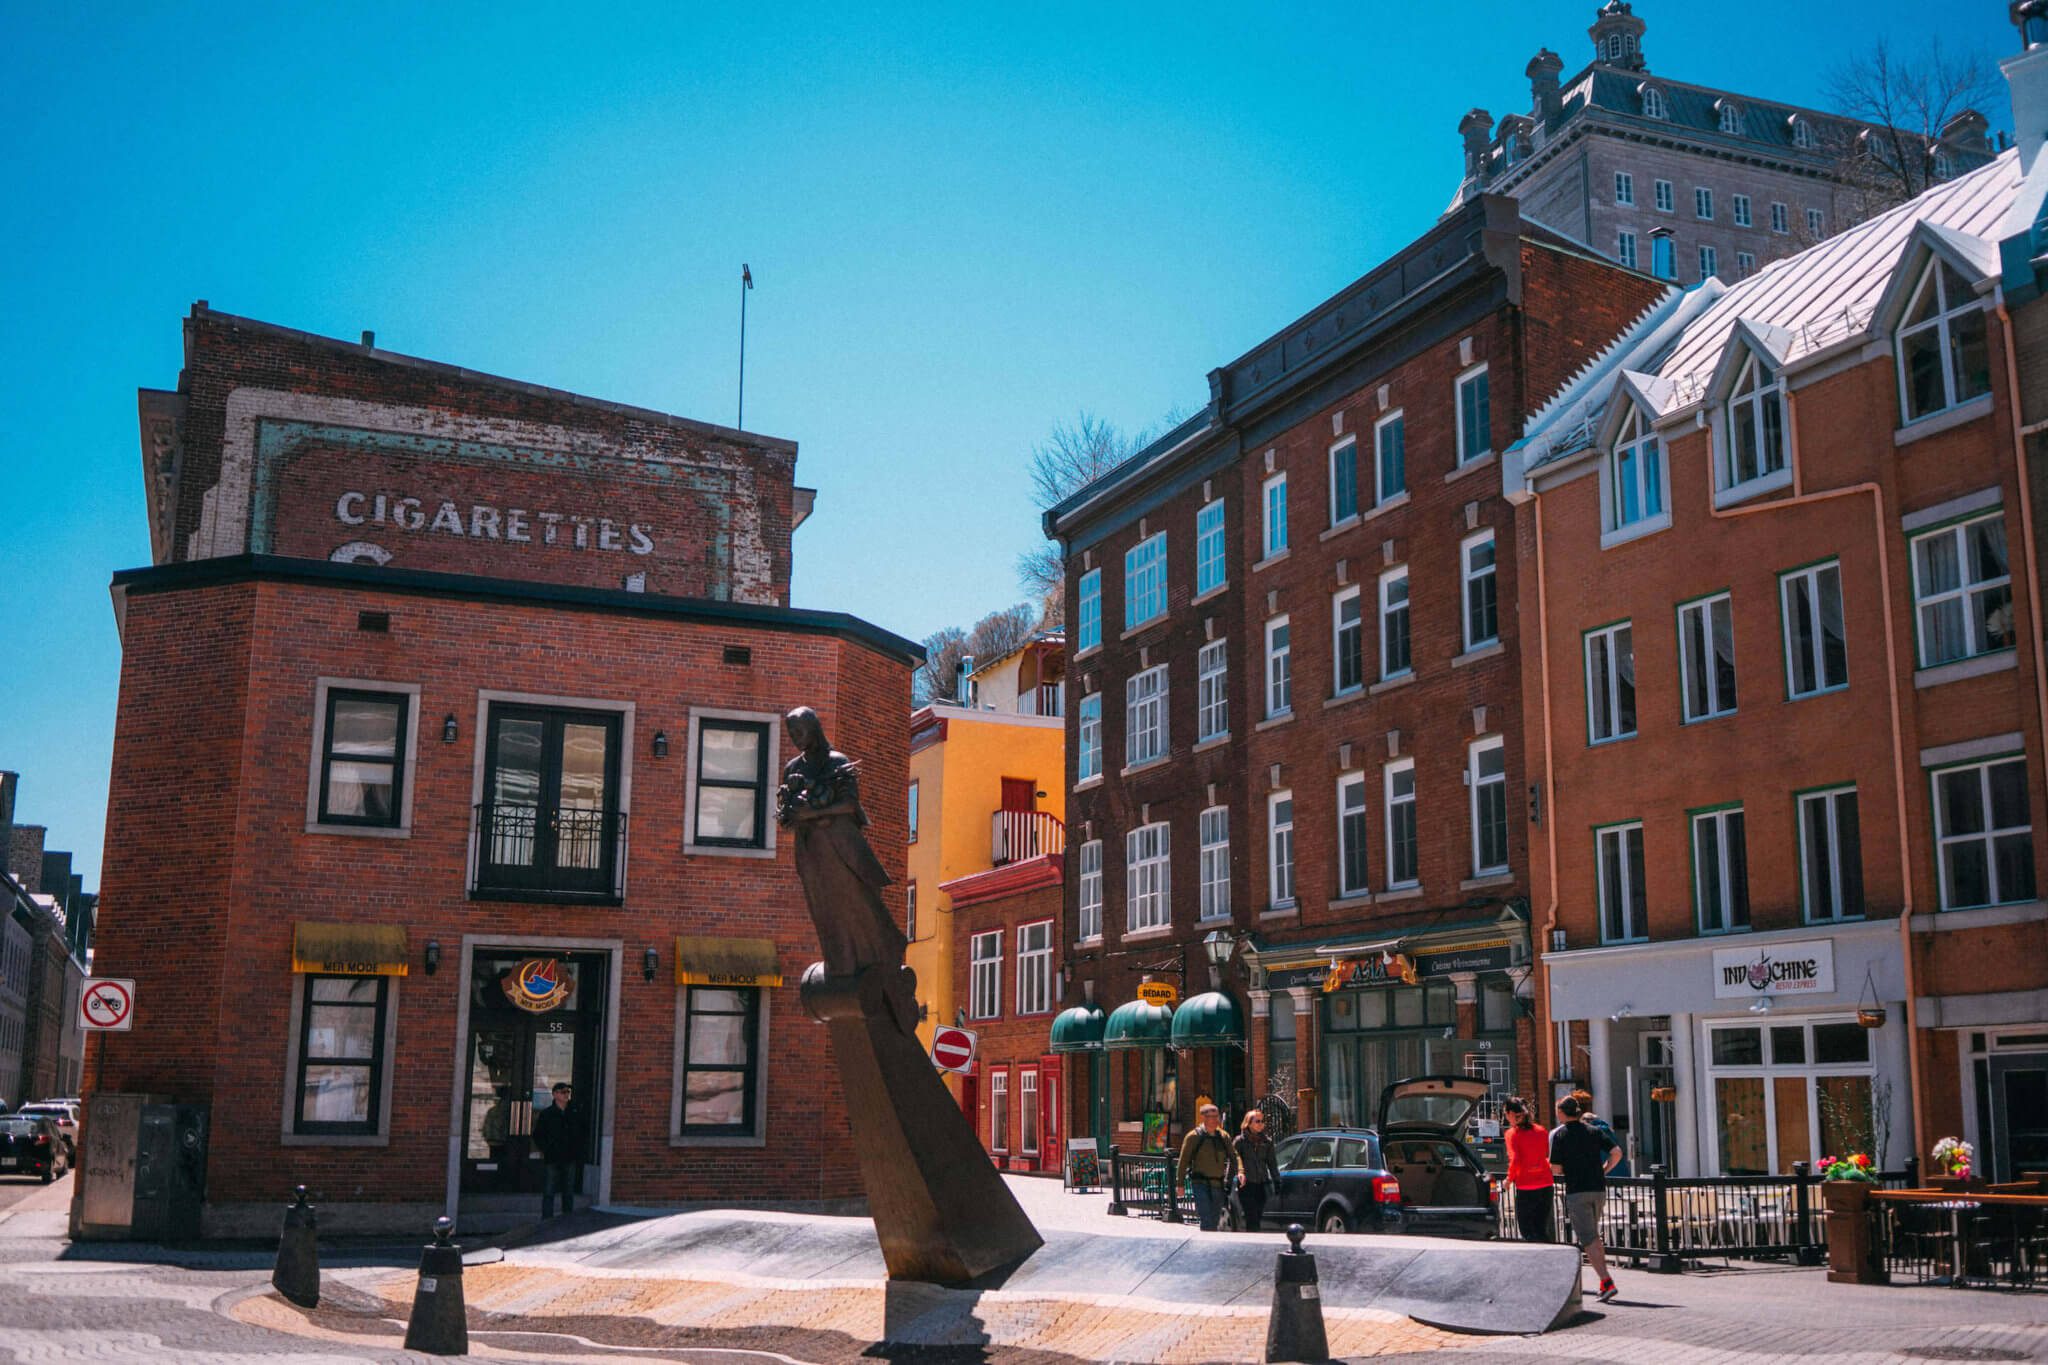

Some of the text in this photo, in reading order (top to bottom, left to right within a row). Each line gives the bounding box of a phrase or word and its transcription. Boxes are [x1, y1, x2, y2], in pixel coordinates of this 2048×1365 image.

[336, 492, 655, 555] CIGARETTES
[347, 961, 379, 972] MODE
[1723, 955, 1819, 990] INDOCHINE
[731, 973, 759, 984] MODE
[1794, 979, 1818, 989] EXPRESS
[549, 1022, 563, 1032] 55
[1480, 1041, 1492, 1050] 89
